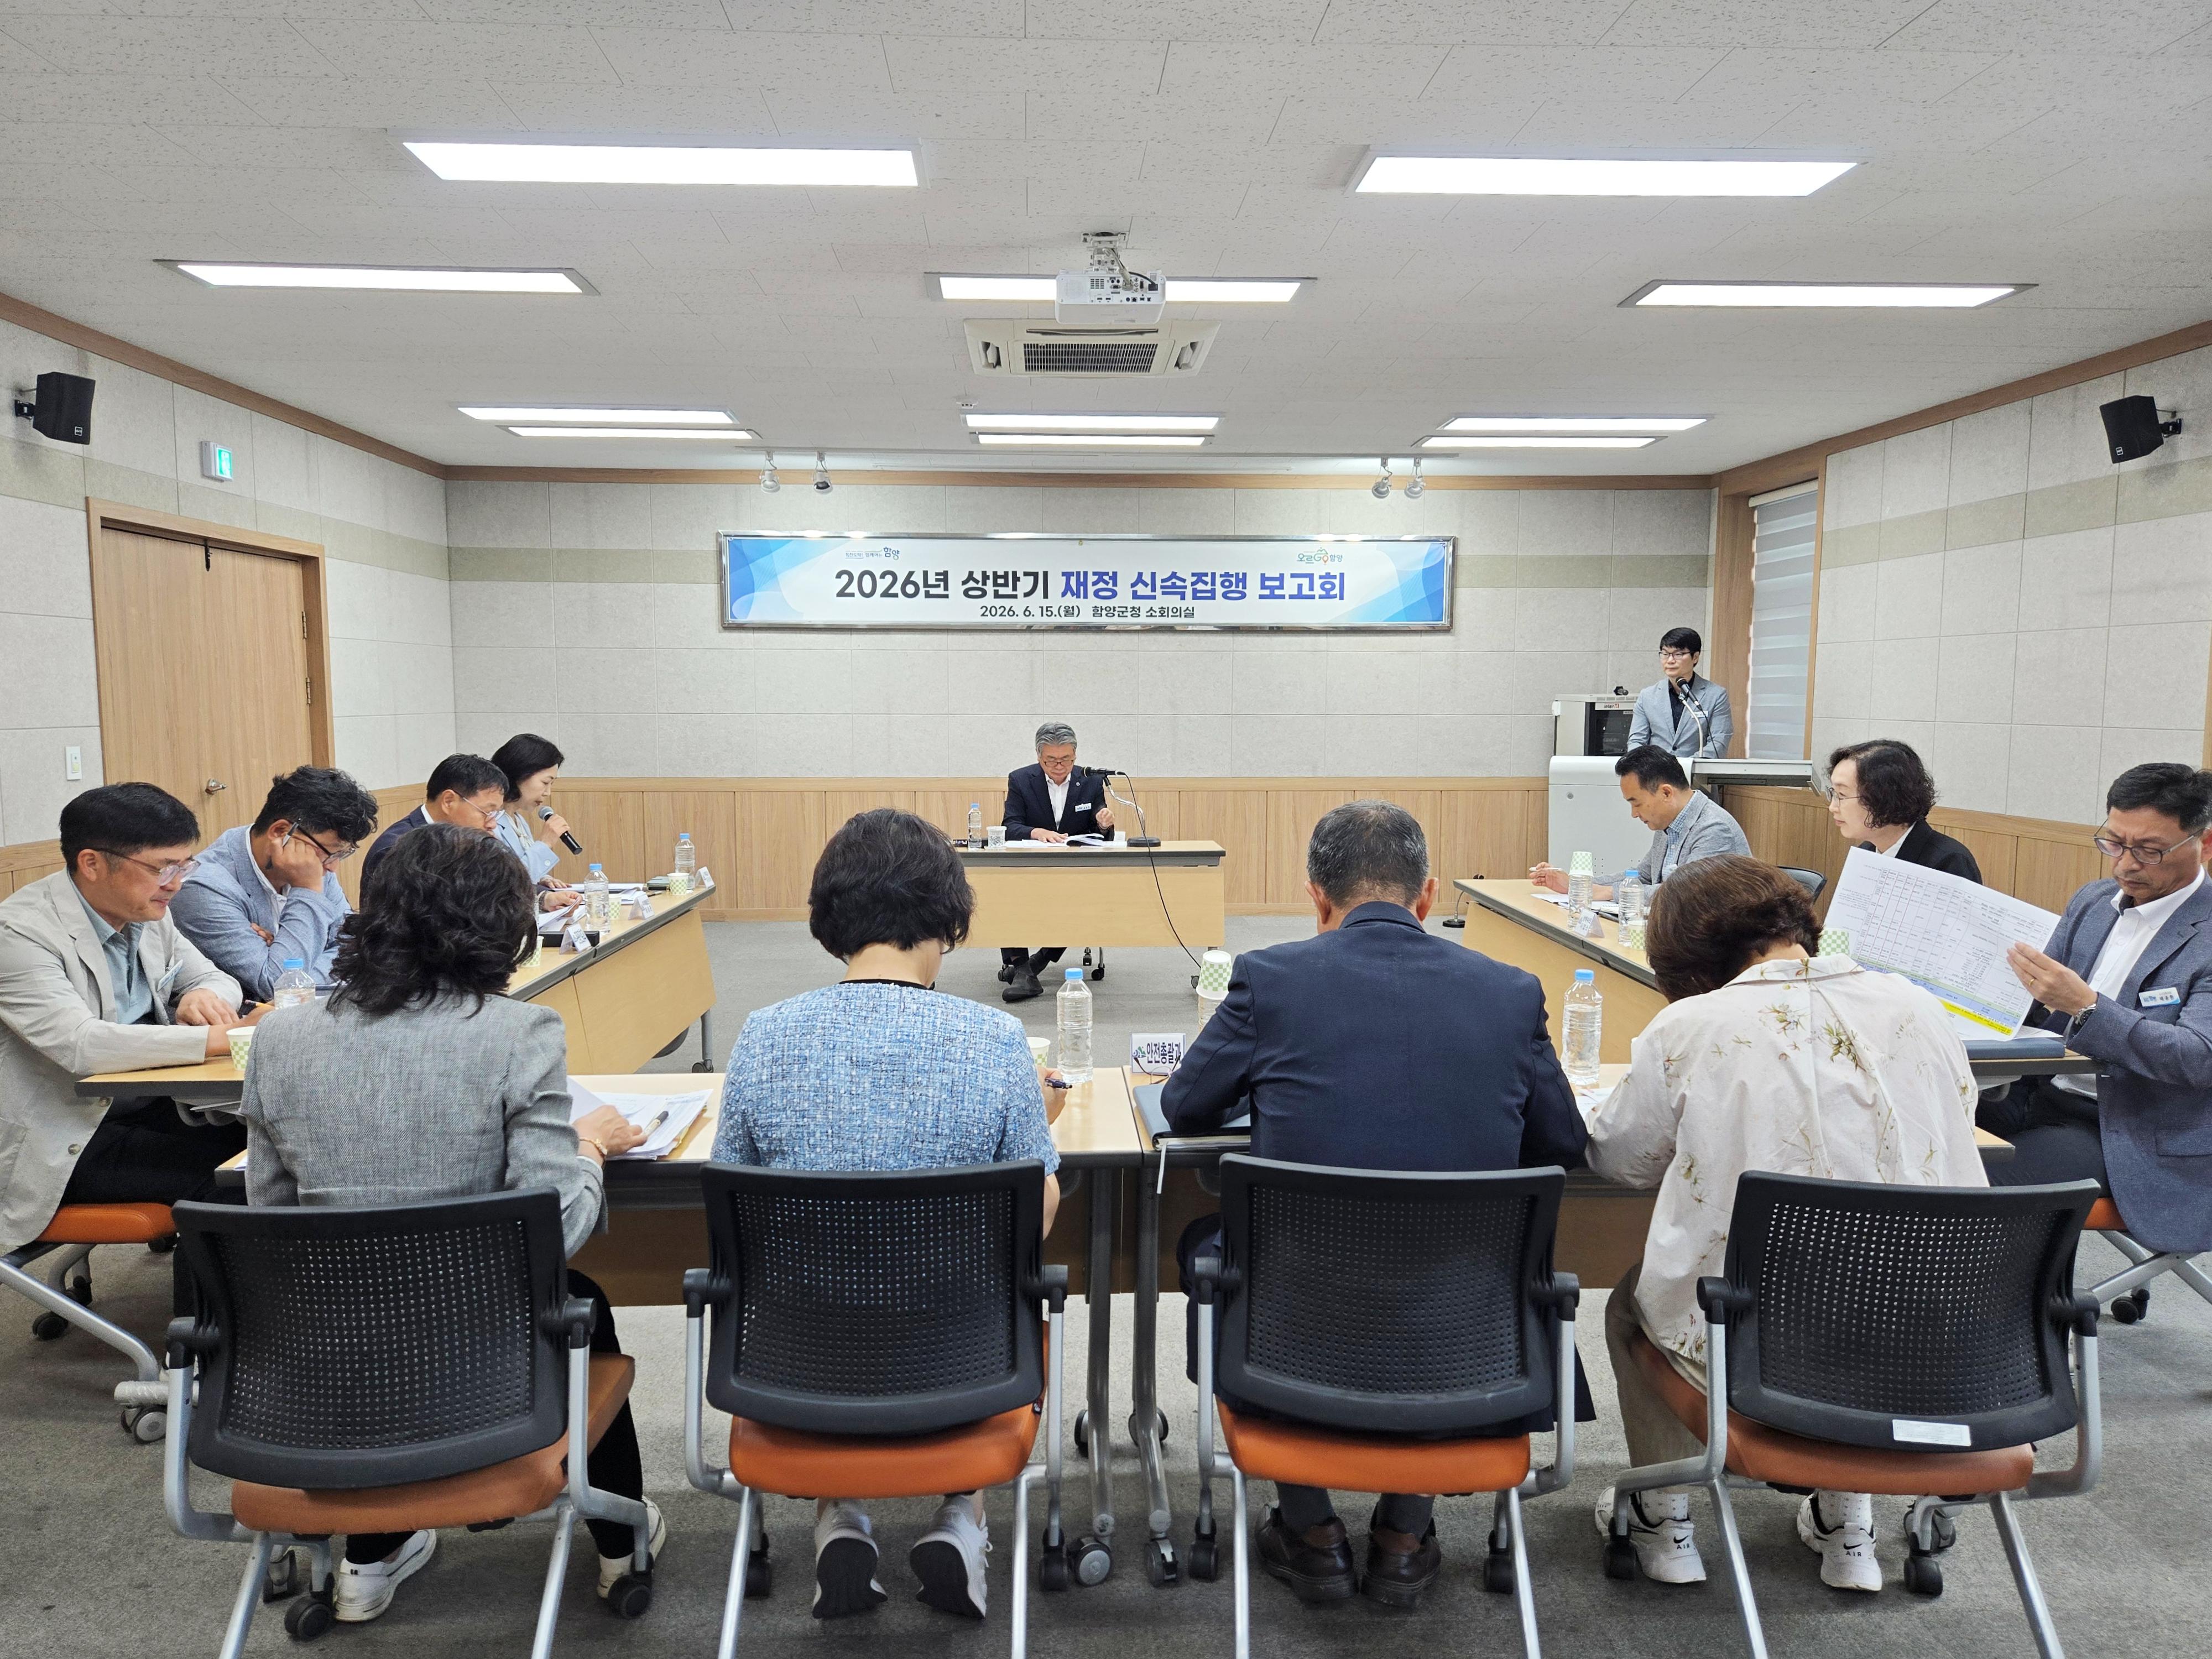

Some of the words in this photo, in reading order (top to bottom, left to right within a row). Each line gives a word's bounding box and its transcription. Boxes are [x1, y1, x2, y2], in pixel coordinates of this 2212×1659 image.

[883, 546, 900, 560] 함양
[835, 570, 950, 599] 2026년
[961, 570, 1048, 599] 상반기
[1061, 571, 1118, 600] 재정
[1130, 571, 1247, 601] 신속집행
[1258, 572, 1344, 601] 보고회
[980, 606, 1019, 617] 2026.
[1023, 606, 1035, 617] 6.
[1039, 605, 1081, 618] 15.(월)
[1092, 605, 1141, 618] 함양군청
[1145, 605, 1194, 618] 소회의실
